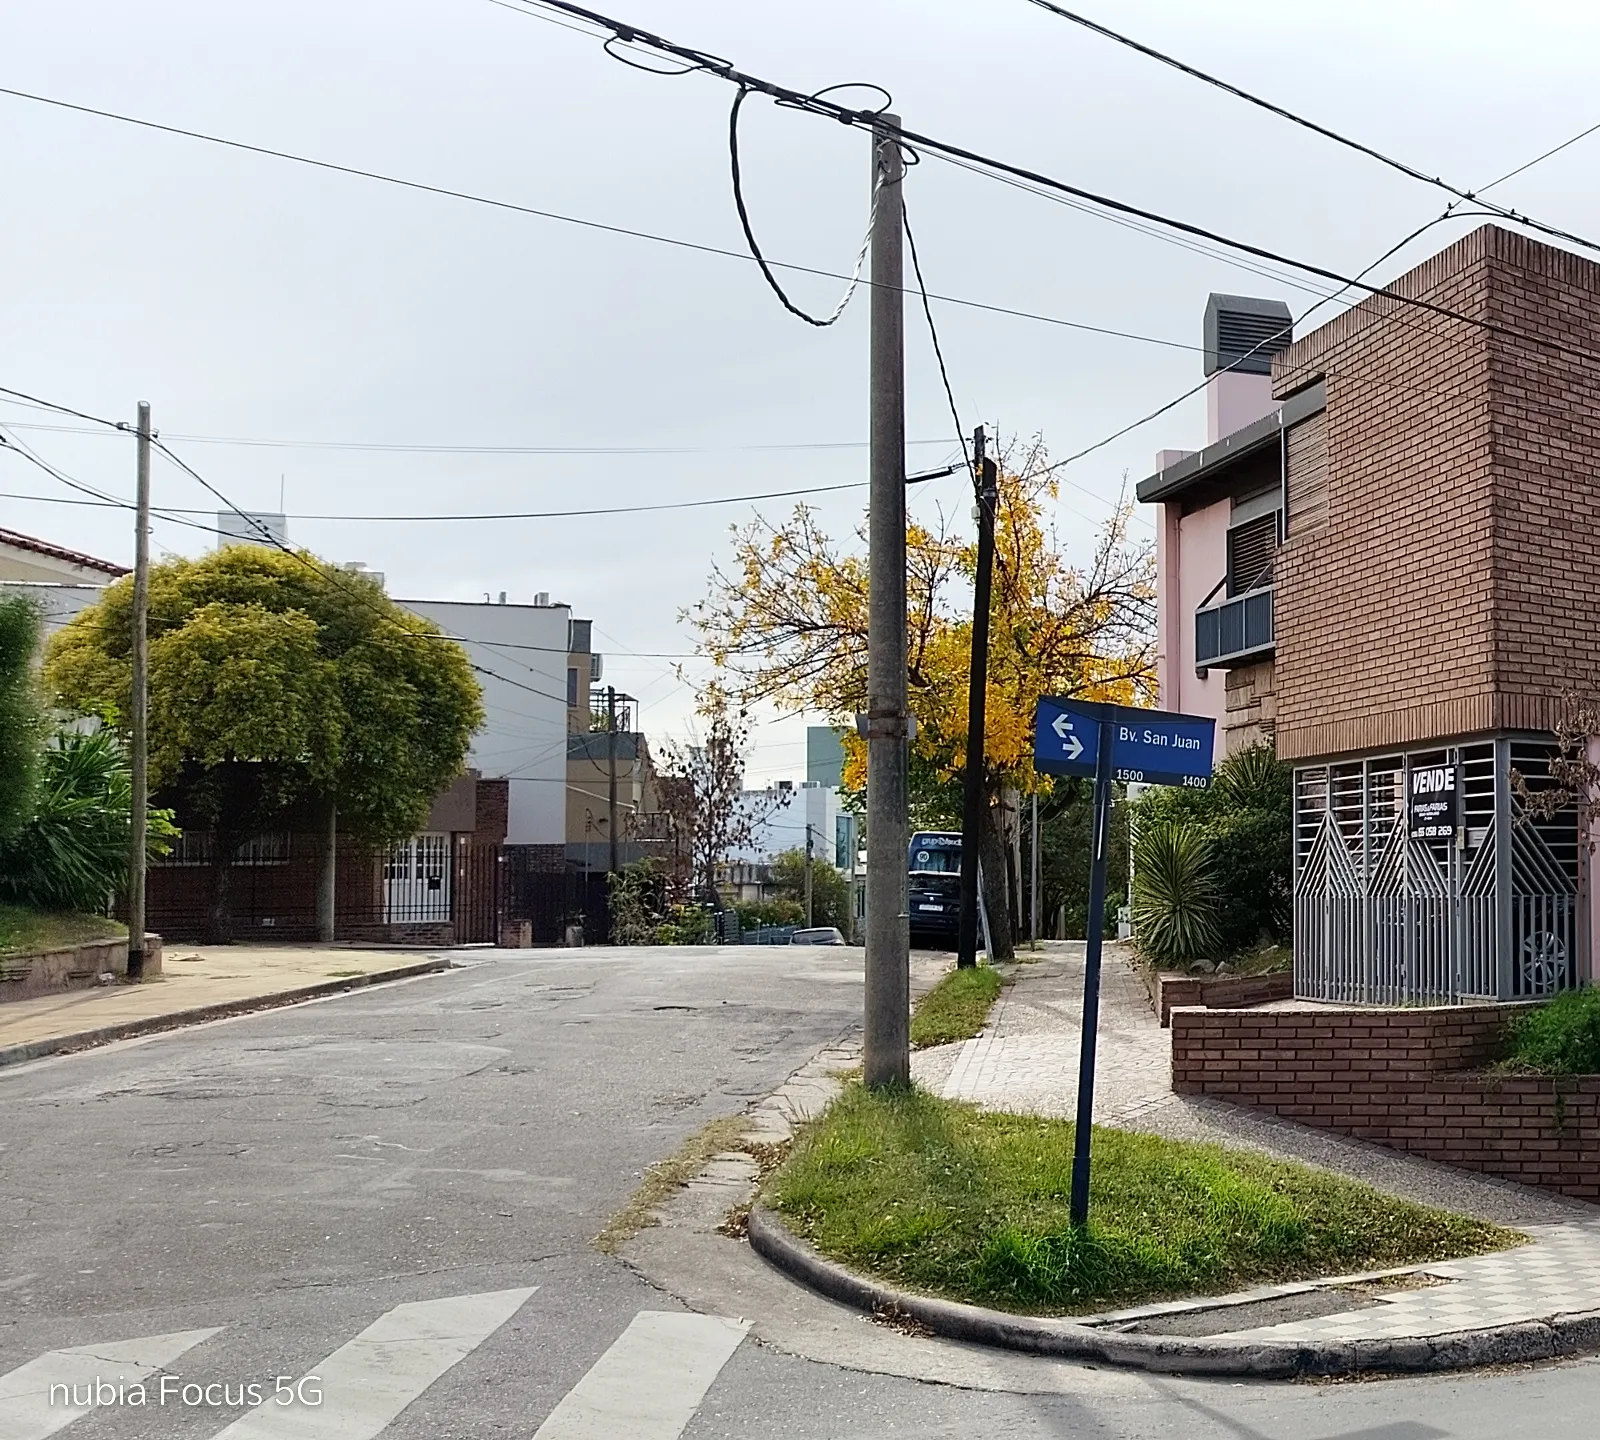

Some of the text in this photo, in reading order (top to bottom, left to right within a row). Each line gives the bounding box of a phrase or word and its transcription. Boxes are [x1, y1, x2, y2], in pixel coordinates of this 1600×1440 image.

[1119, 726, 1201, 751] Bv. San Juan
[1116, 768, 1144, 782] 1500
[1182, 775, 1207, 788] 1400
[1413, 767, 1455, 795] VENDE
[1438, 825, 1452, 836] 269
